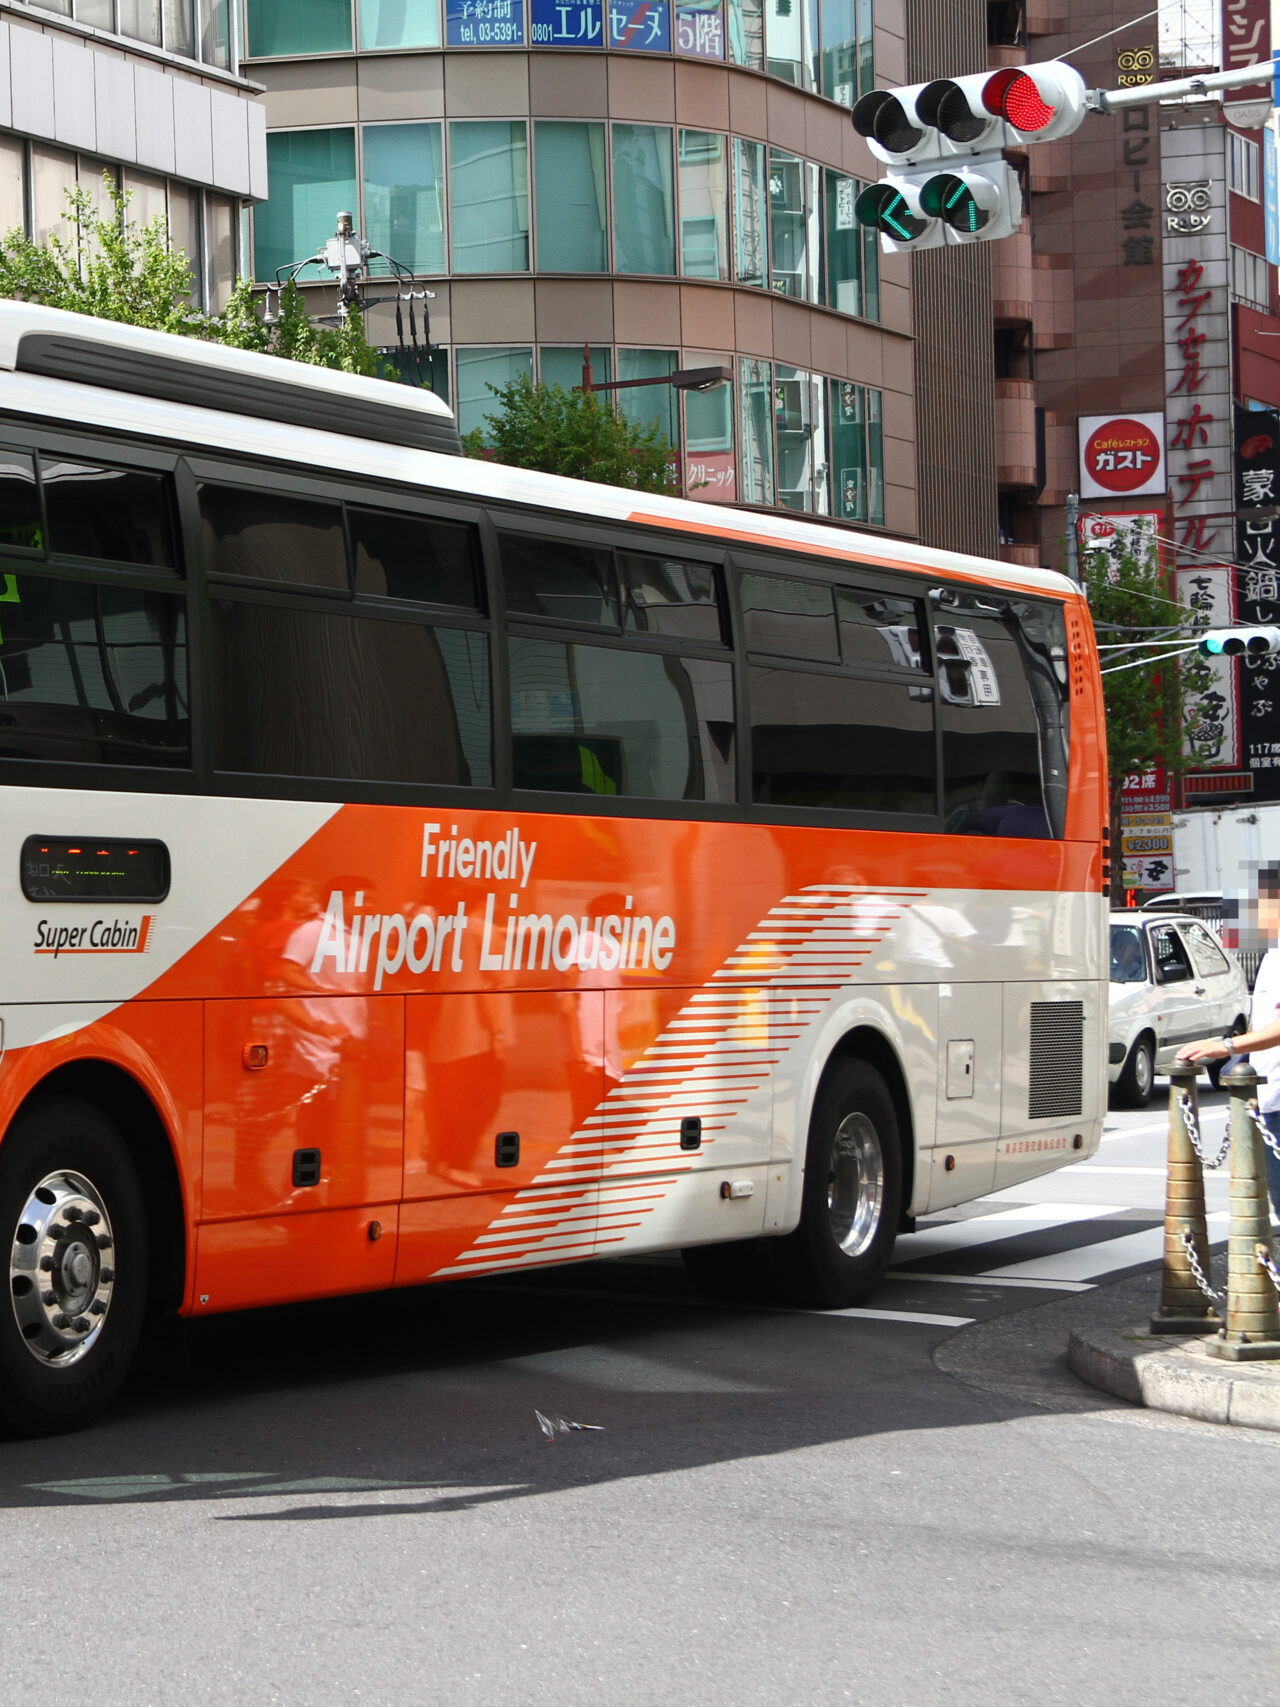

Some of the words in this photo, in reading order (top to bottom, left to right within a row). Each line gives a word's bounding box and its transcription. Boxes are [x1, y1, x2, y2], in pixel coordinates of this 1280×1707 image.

[460, 0, 511, 20] 予約制
[460, 24, 477, 45] tel,
[677, 12, 722, 56] 5階
[1117, 73, 1154, 87] Roby
[1233, 109, 1263, 120] OASIS
[1122, 105, 1155, 267] ロビー会館
[1095, 450, 1153, 471] ガスト
[687, 462, 736, 487] クリニック
[421, 823, 537, 888] Friendly
[33, 919, 88, 959] Super
[89, 919, 138, 948] Cabin
[310, 890, 468, 991] Airport
[479, 893, 676, 972] Limousine
